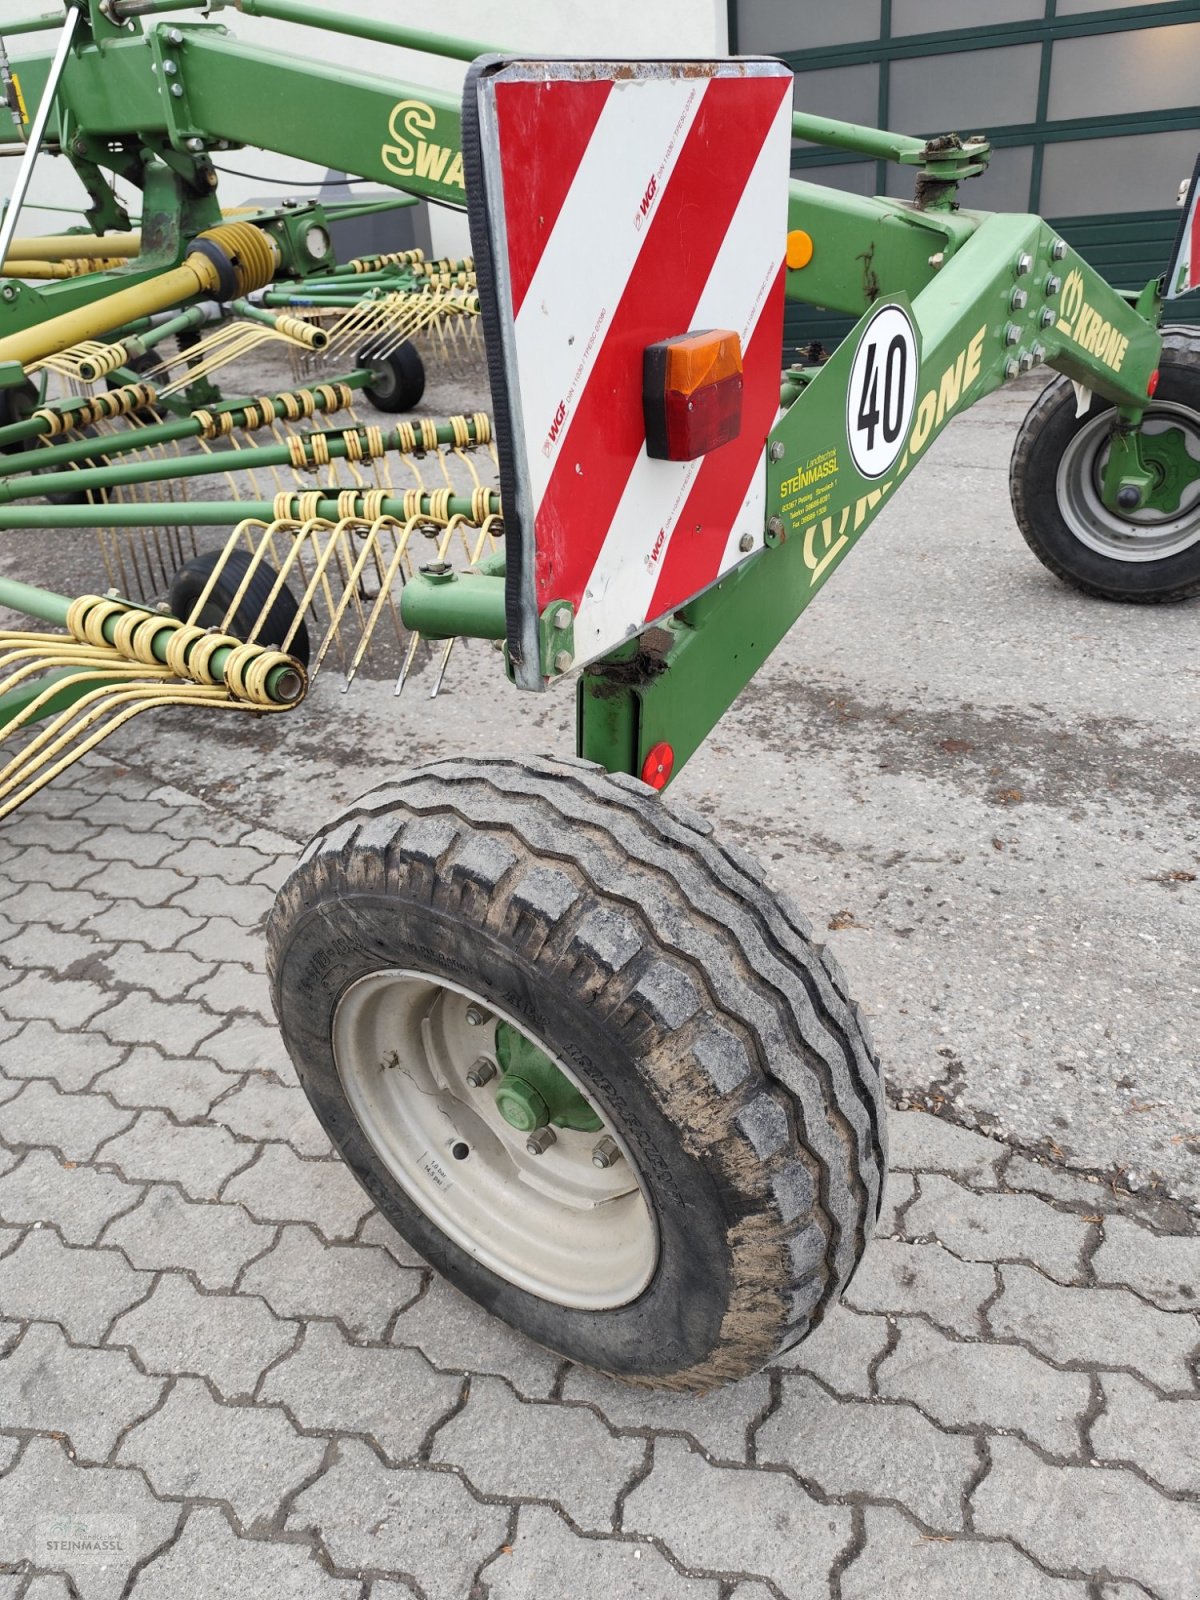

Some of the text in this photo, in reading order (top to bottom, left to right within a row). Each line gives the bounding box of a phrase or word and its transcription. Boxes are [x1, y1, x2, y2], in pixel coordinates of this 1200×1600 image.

[639, 174, 657, 216] WGF
[1072, 302, 1130, 372] KRONE
[857, 334, 907, 451] 40
[548, 400, 567, 442] WGF
[780, 457, 839, 498] STEINMASSL
[650, 527, 666, 562] WGF
[437, 1168, 447, 1178] bar
